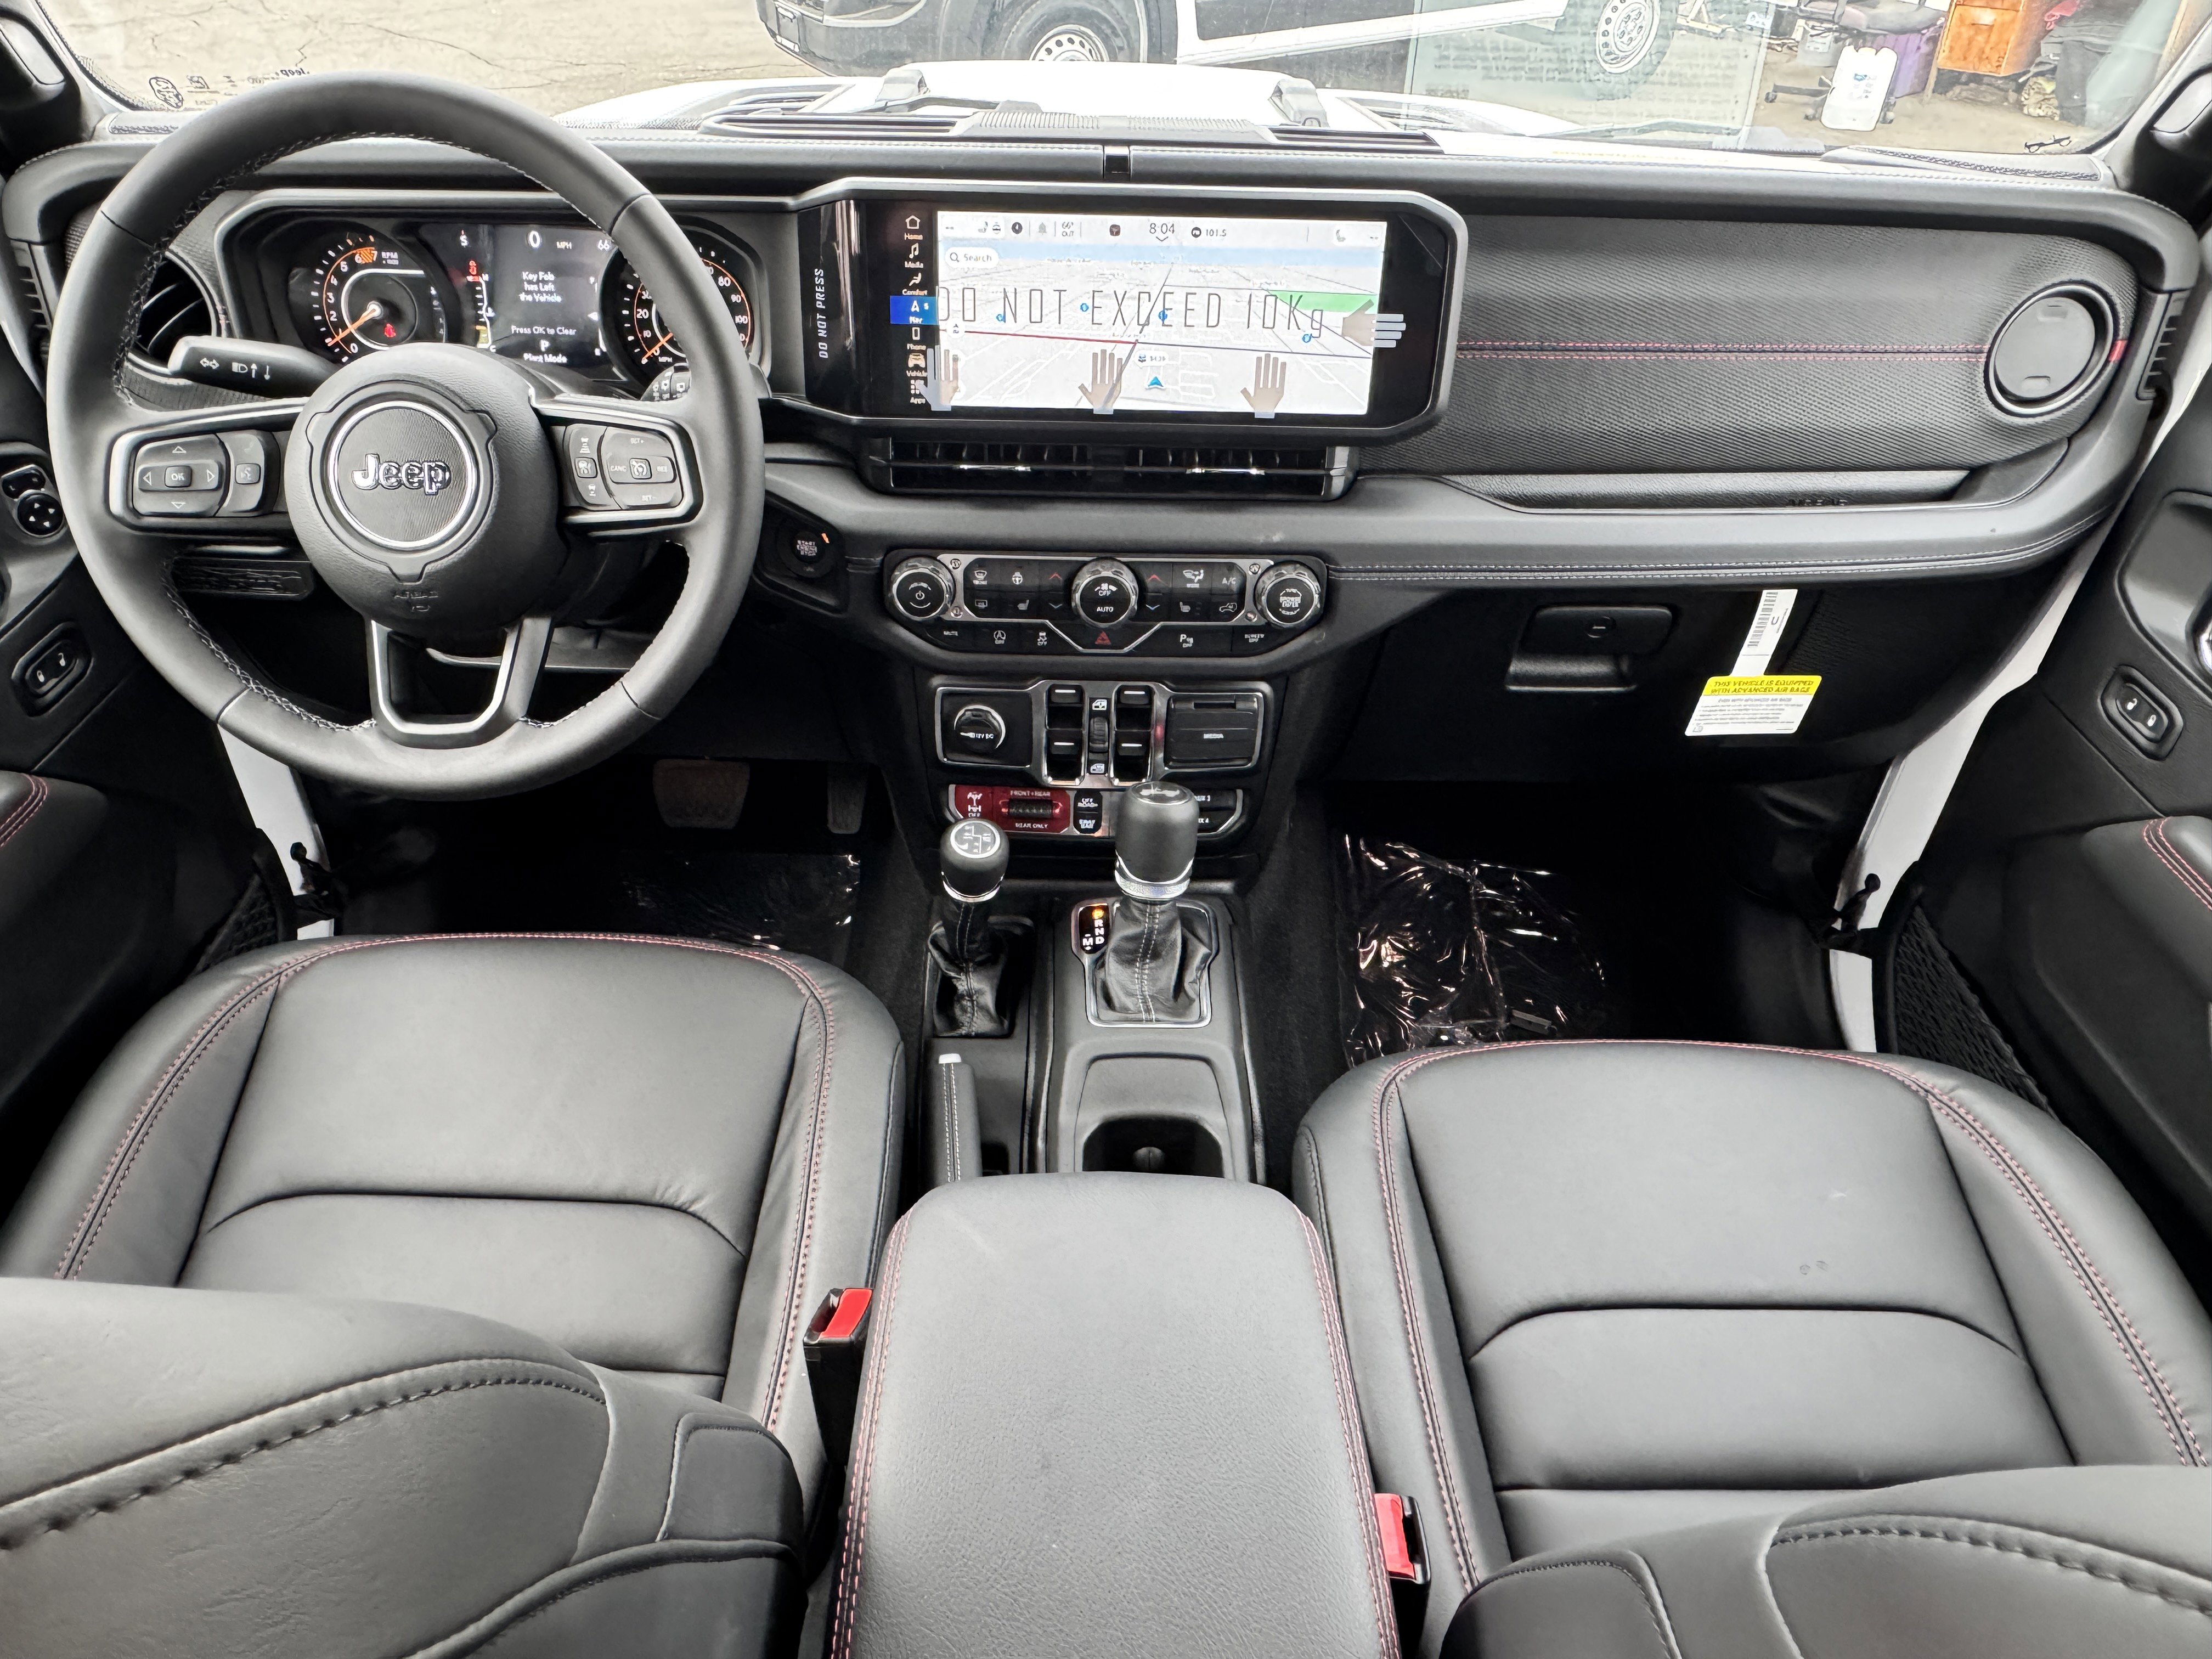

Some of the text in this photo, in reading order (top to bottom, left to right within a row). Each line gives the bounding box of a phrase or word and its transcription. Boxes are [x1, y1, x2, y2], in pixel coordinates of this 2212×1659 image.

[1149, 223, 1175, 234] 8:04
[528, 230, 540, 248] 0
[355, 253, 362, 263] 6
[371, 251, 377, 261] 7
[340, 261, 348, 272] 5
[330, 274, 338, 286] 4
[522, 272, 555, 282] Key Fob
[718, 275, 731, 286] 80
[524, 281, 555, 291] has Left
[327, 292, 335, 303] 3
[518, 292, 562, 302] the Vehicle
[330, 311, 337, 321] 2
[636, 309, 649, 319] 20
[815, 268, 828, 359] DO NOT PRESS
[1003, 287, 1067, 324] NOT
[1091, 290, 1221, 328] EXCEED
[1246, 292, 1323, 338] 10Kg
[511, 325, 531, 334] Press
[533, 326, 545, 334] OK
[556, 326, 576, 335] Clear
[350, 343, 358, 353] 0
[540, 340, 550, 352] P
[544, 353, 568, 363] Mode
[171, 473, 185, 481] OK
[352, 453, 452, 495] Jeep
[1095, 928, 1104, 936] N
[1082, 937, 1093, 946] M
[1095, 936, 1104, 944] D
